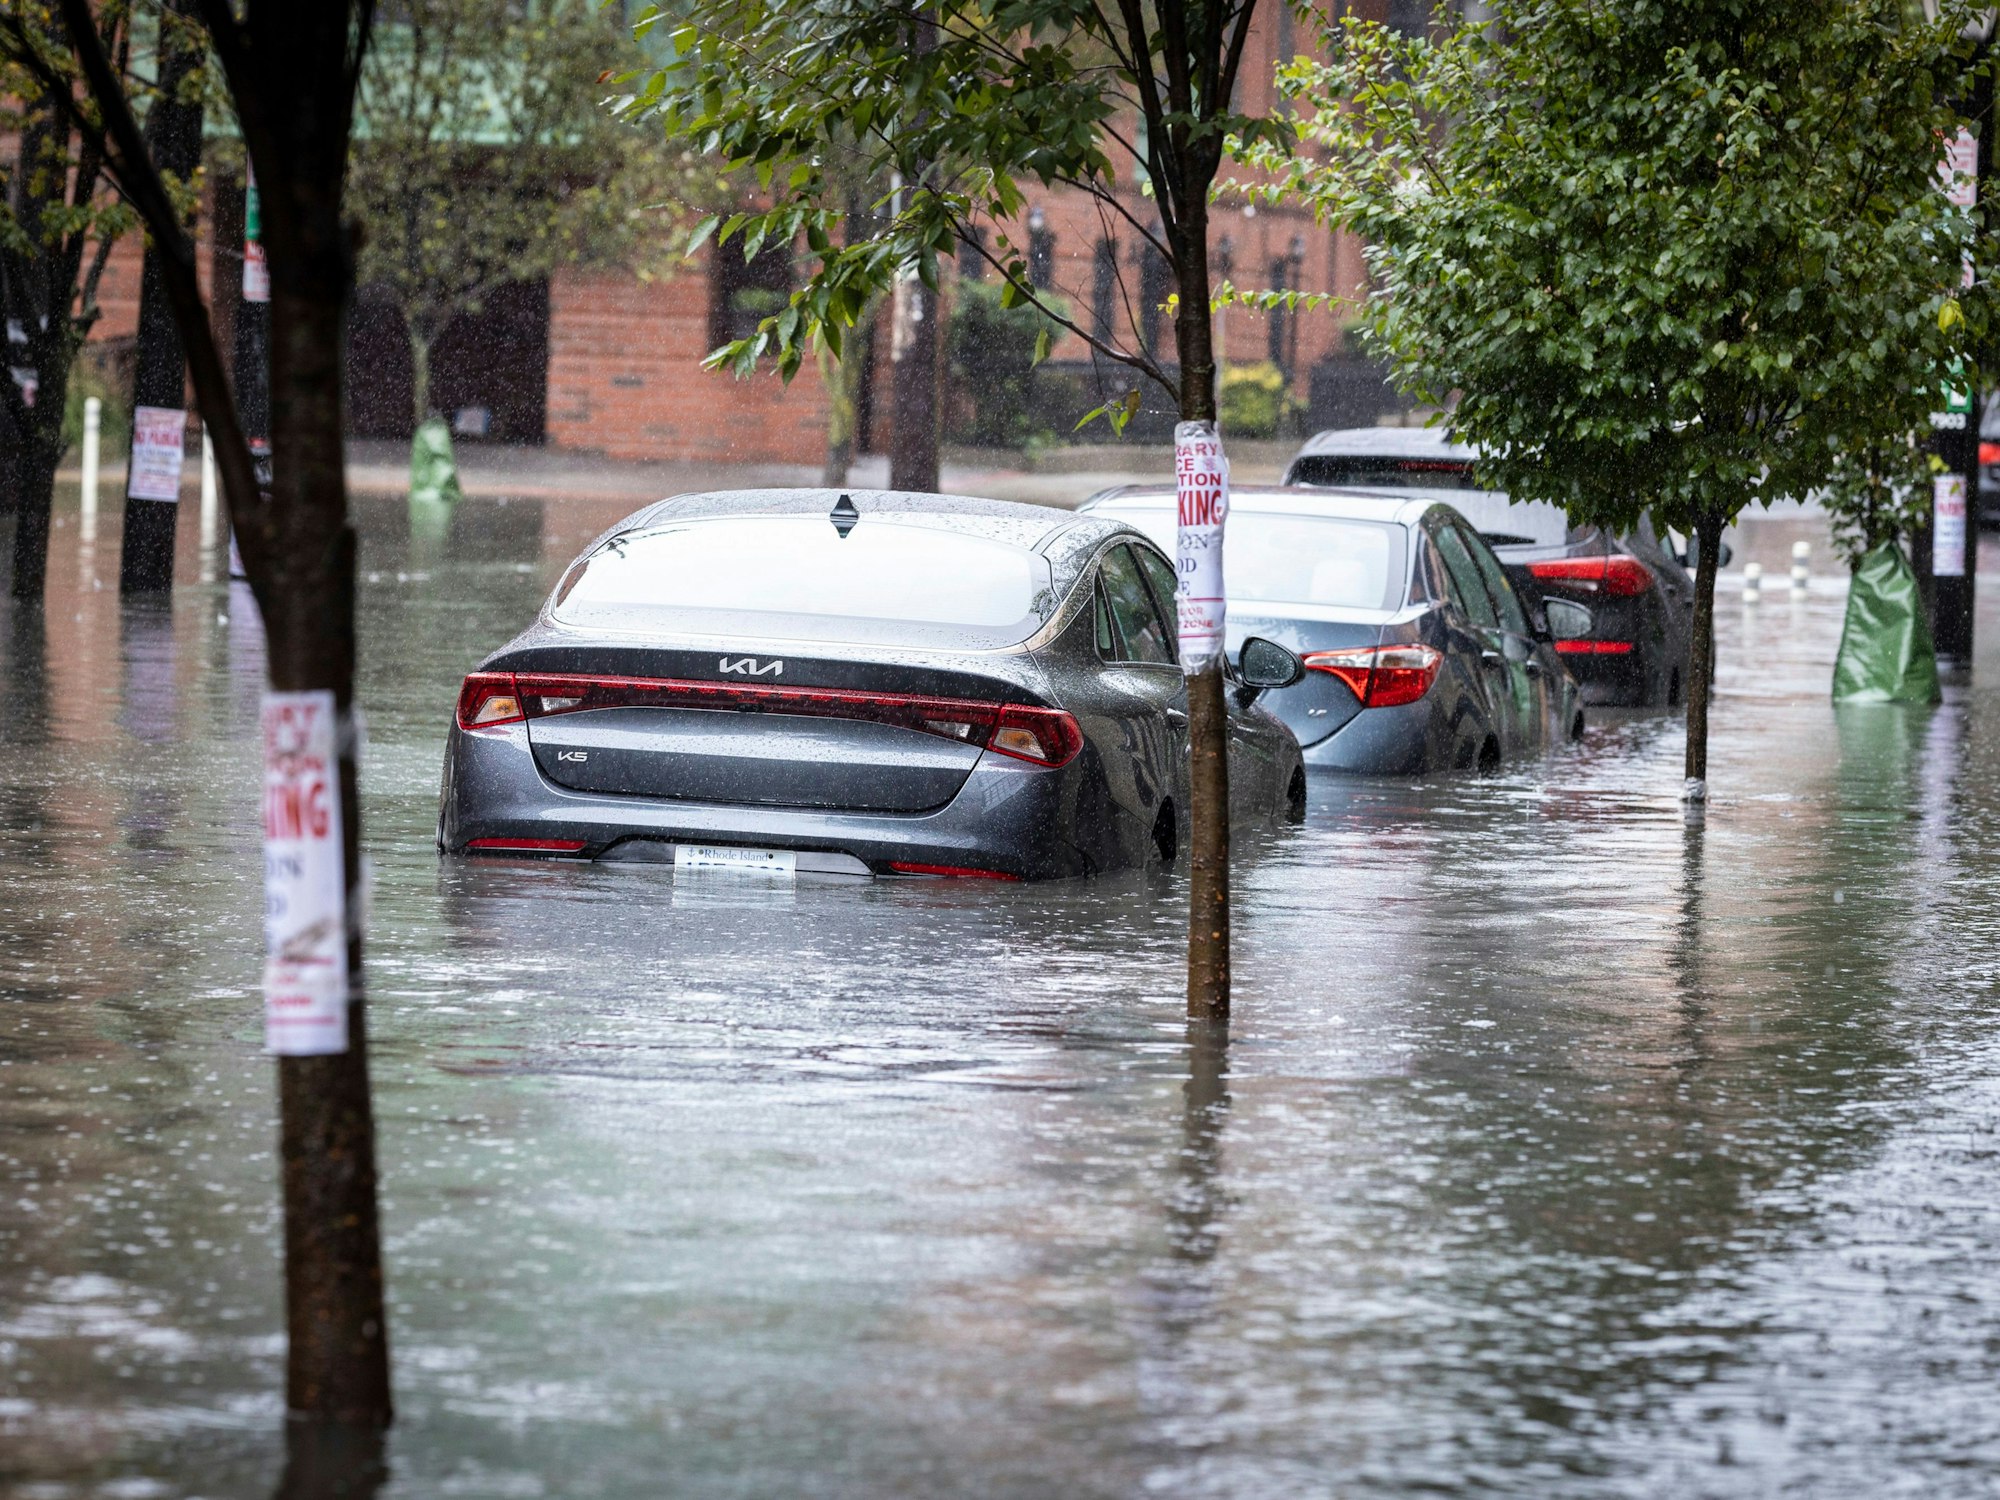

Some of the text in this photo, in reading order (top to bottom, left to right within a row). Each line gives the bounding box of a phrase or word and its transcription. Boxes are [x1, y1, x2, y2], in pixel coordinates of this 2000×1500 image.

[1178, 490, 1222, 527] KING
[719, 656, 783, 676] KIA
[557, 750, 588, 762] K5
[704, 849, 768, 862] Rhode Island
